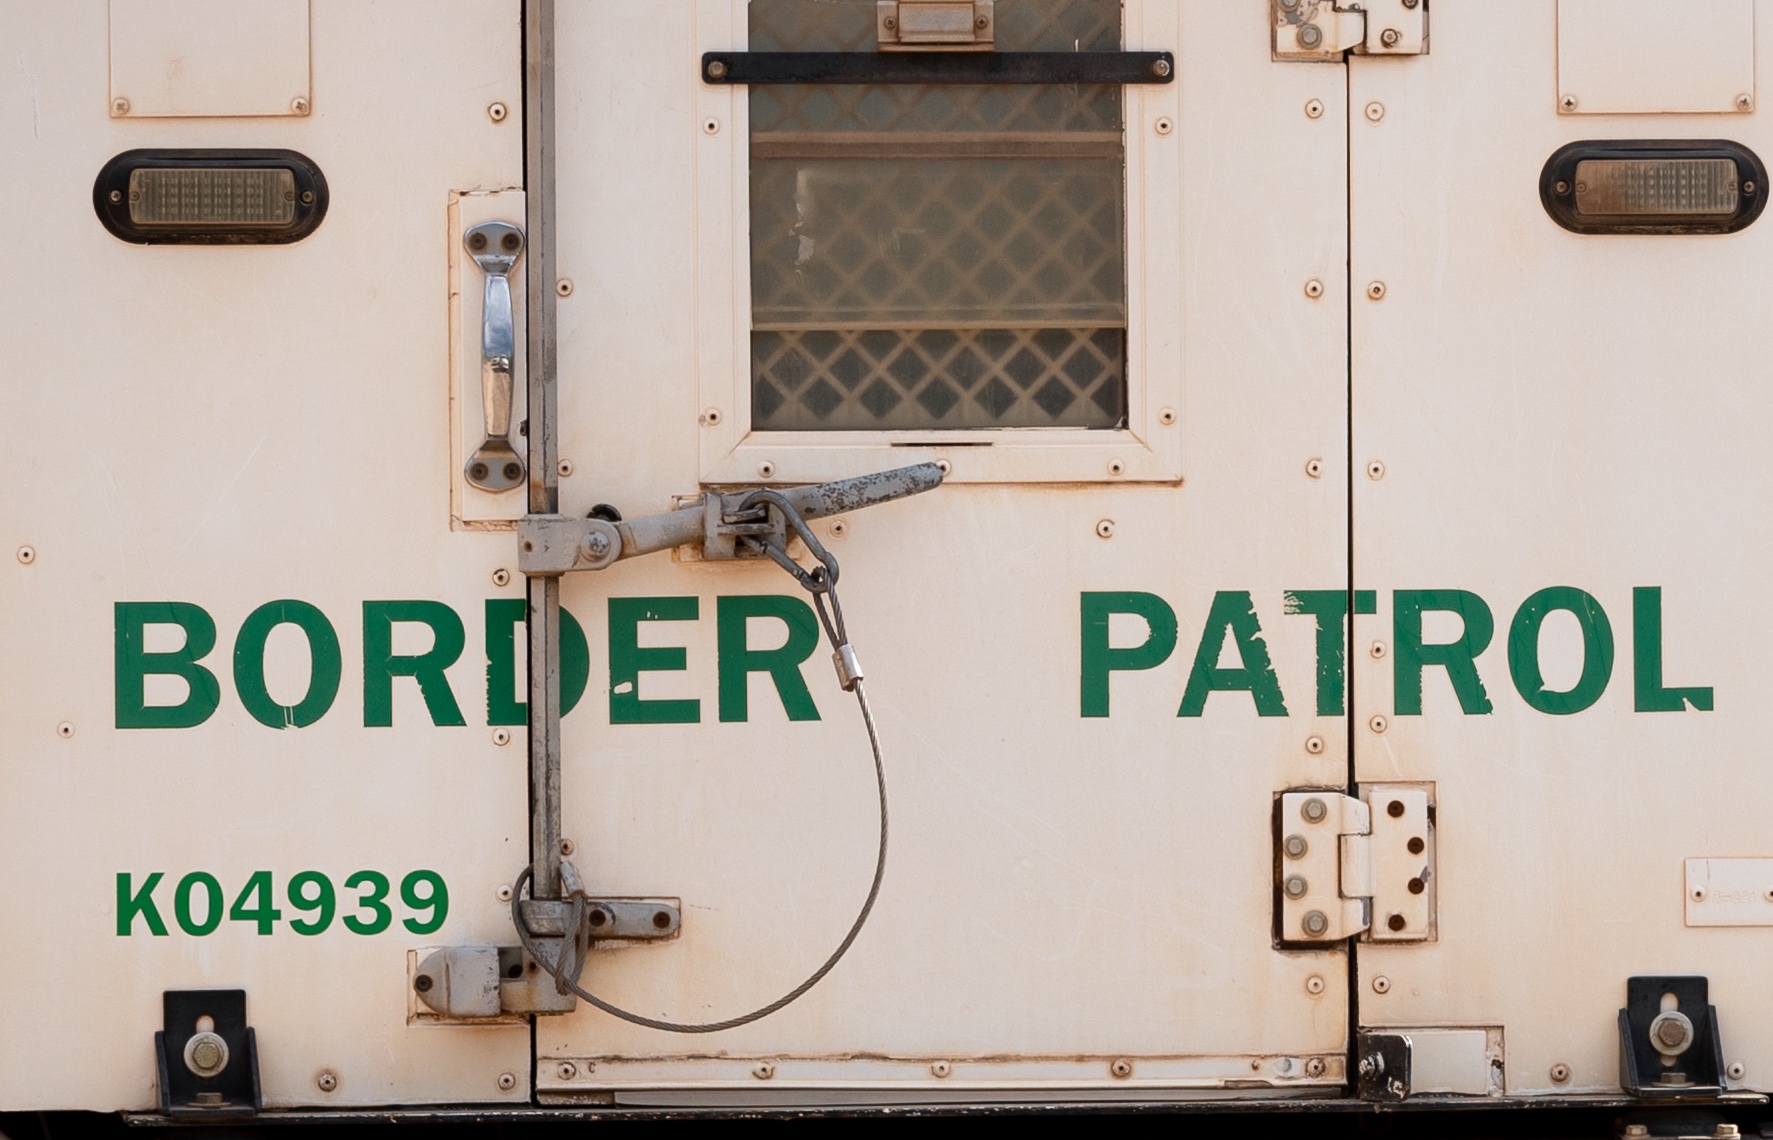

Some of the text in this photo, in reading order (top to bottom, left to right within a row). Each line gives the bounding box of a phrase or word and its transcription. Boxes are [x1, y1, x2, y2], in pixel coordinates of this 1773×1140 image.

[115, 586, 1715, 729] BORDER PATROL
[116, 870, 449, 936] K04939
